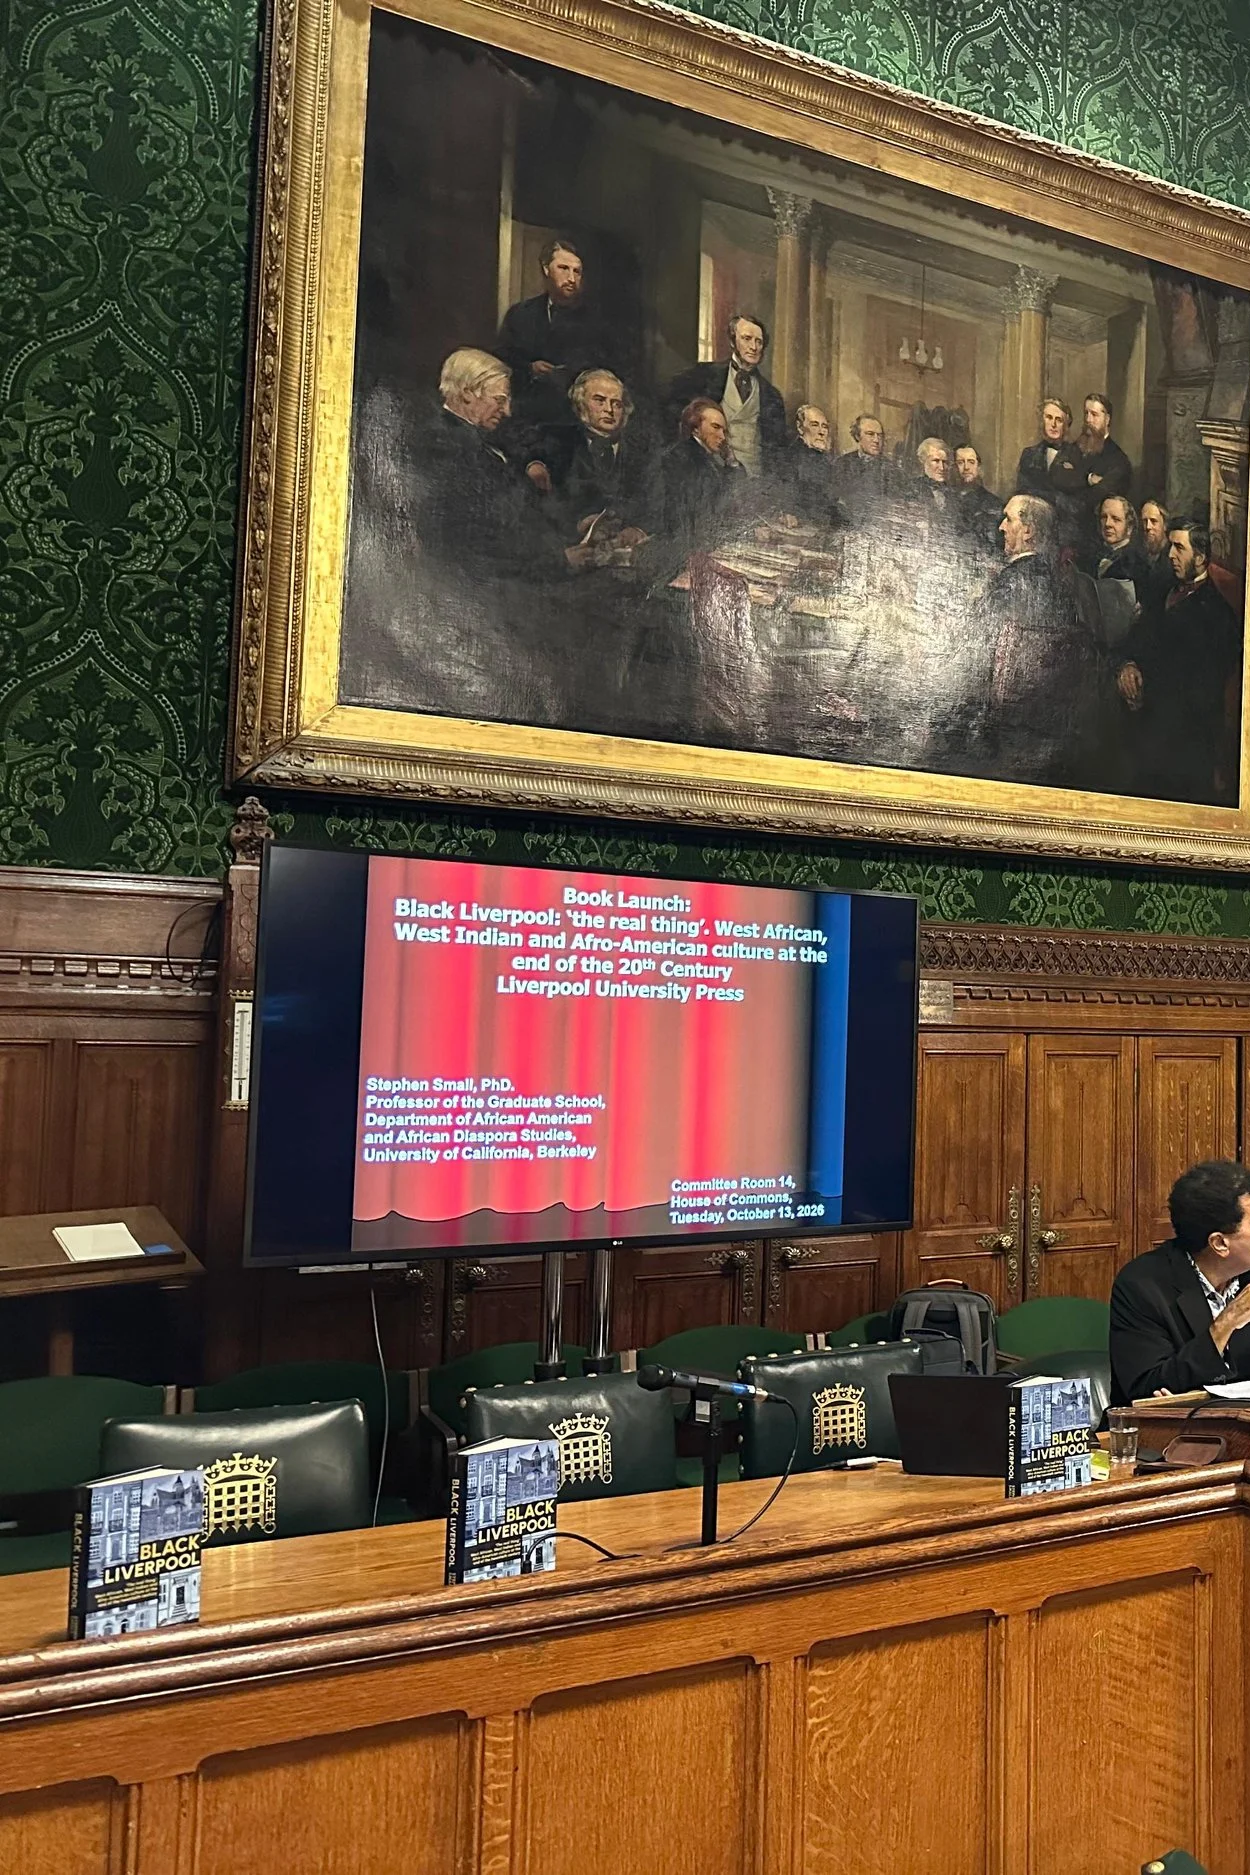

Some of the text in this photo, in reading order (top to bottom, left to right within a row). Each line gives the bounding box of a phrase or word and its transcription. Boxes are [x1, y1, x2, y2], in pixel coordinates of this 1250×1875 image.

[563, 888, 691, 913] Book Launch:
[395, 898, 455, 919] Black
[460, 903, 561, 927] Liverpool:
[609, 915, 646, 932] real
[714, 920, 760, 938] West
[763, 923, 828, 945] African,
[394, 923, 828, 964] West Indian and Afro-American culture at the
[512, 954, 733, 983] end of the 20th Century
[497, 976, 745, 1004] Liverpool University Press
[366, 1077, 515, 1095] Stephen Small, PhD.
[366, 1094, 606, 1109] Professor of the Graduate School,
[365, 1112, 592, 1129] Department of African American
[364, 1128, 577, 1145] and African Diaspora Studies,
[363, 1145, 597, 1163] University of California, Berkeley
[671, 1175, 796, 1192] Committee Room 14,
[670, 1192, 793, 1208] House of Commons,
[669, 1204, 825, 1225] Tuesday, October 13, 2026
[1052, 1429, 1090, 1446] BLACK
[1032, 1442, 1090, 1462] LIVERPOOL
[451, 1478, 460, 1515] BLACK
[506, 1499, 555, 1523] BLACK
[72, 1513, 83, 1553] BLACK
[448, 1517, 459, 1566] LIVERPOOL
[478, 1515, 555, 1544] LIVERPOOL
[139, 1534, 200, 1561] BLACK
[104, 1551, 200, 1584] LIVERPOOL
[70, 1555, 81, 1609] LIVERPOOL
